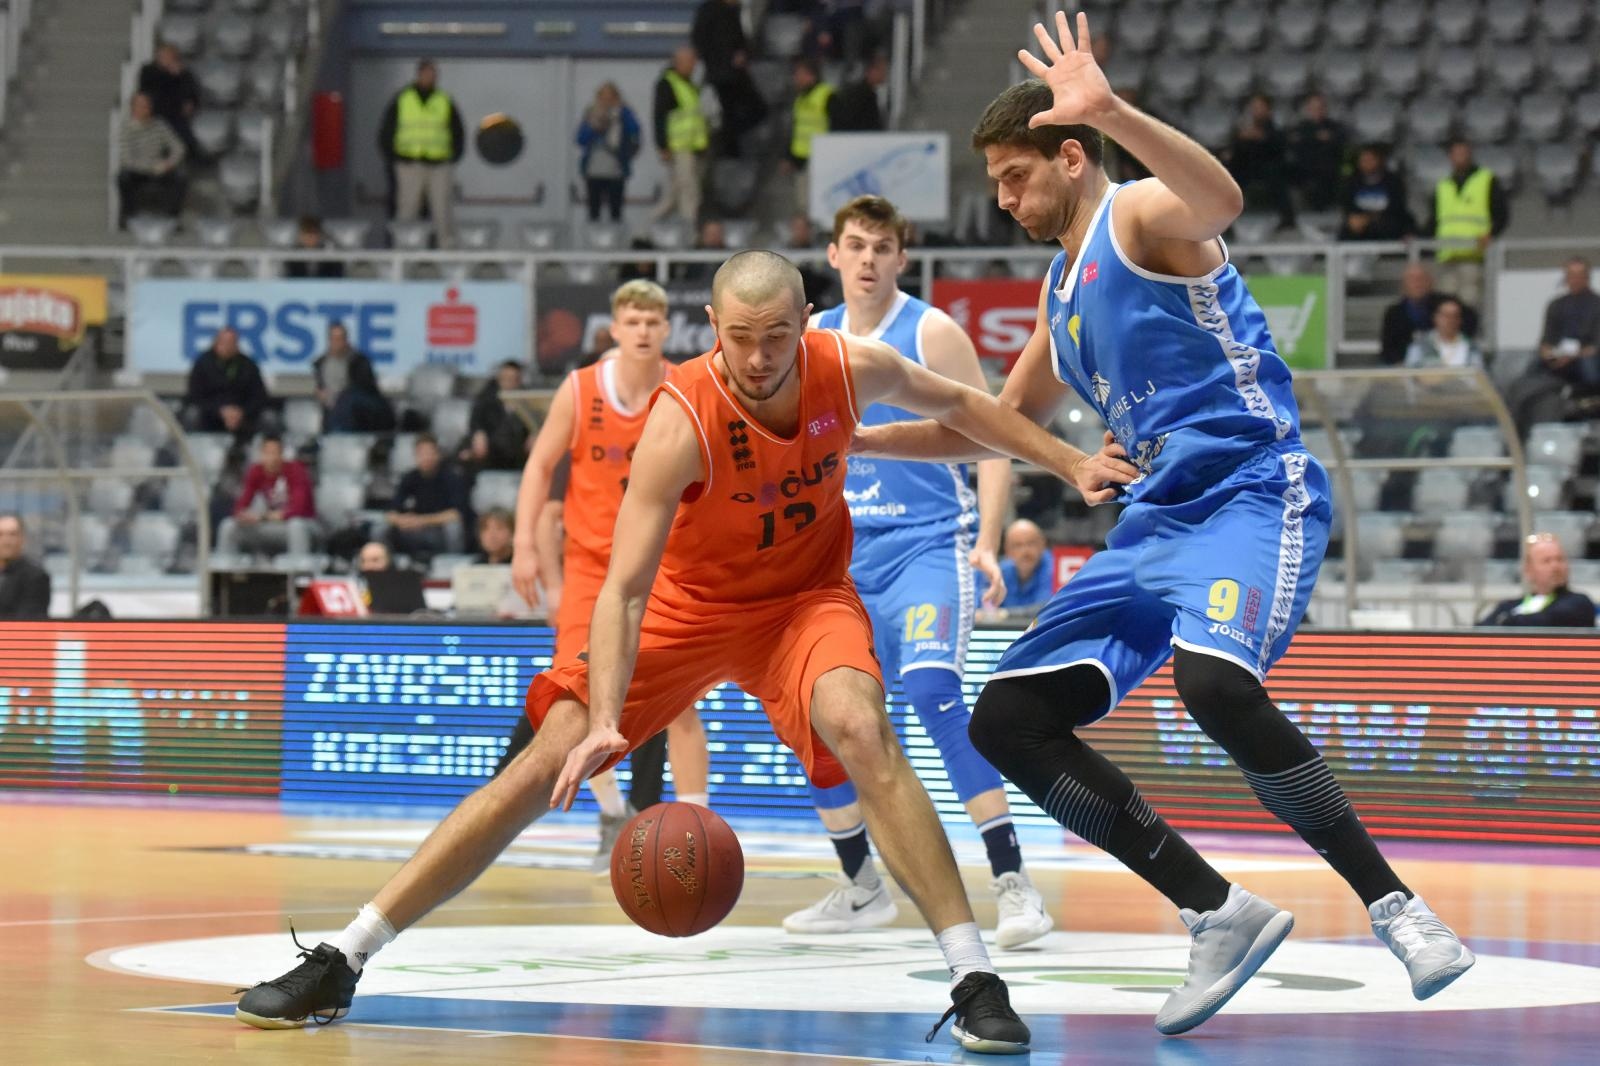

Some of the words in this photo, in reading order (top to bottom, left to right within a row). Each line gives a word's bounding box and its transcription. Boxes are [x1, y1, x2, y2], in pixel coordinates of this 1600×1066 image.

[182, 301, 396, 364] ERSTE
[905, 603, 938, 643] 12
[1206, 579, 1240, 622] 9
[630, 819, 656, 909] SPALDING
